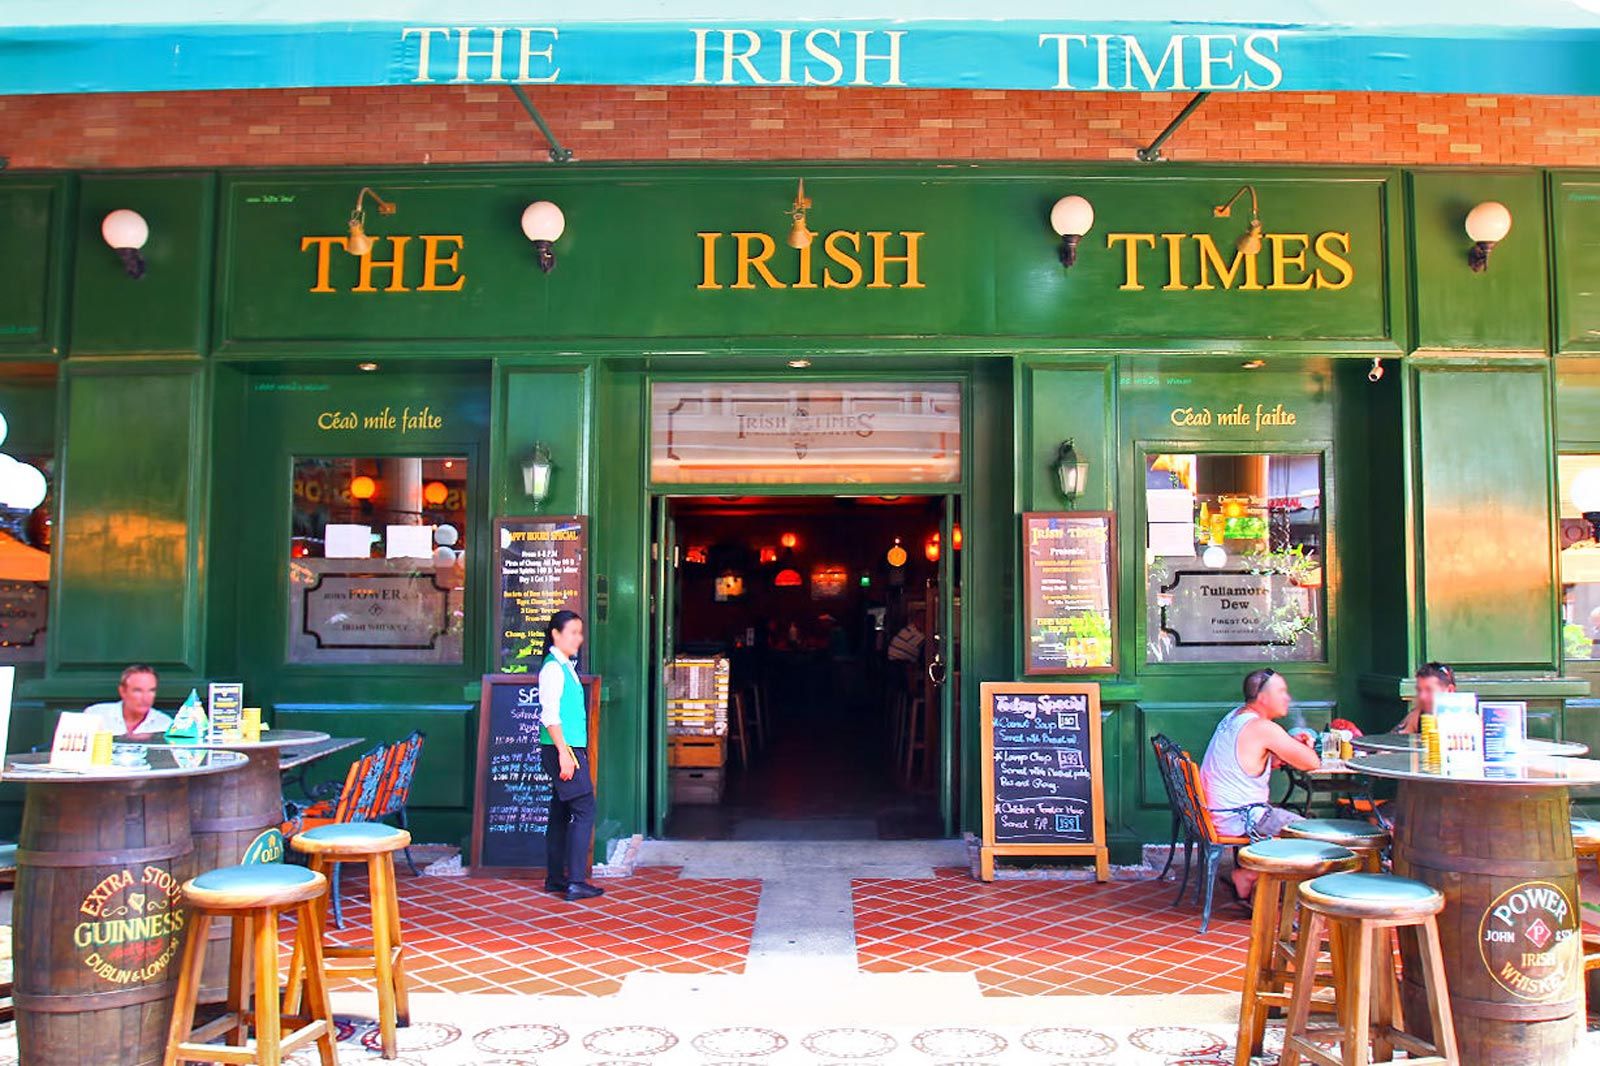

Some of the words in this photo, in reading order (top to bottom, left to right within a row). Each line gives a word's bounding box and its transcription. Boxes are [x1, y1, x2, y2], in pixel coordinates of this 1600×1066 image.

[401, 26, 560, 84] THE
[688, 28, 907, 87] IRISH
[1038, 33, 1283, 92] TIMES
[300, 233, 467, 294] THE
[696, 230, 926, 291] IRISH
[1107, 231, 1355, 293] TIMES
[317, 410, 359, 430] Céad
[363, 406, 397, 430] mile
[402, 406, 443, 435] failte
[1170, 406, 1212, 428] Céad
[1217, 403, 1250, 427] mile
[1255, 403, 1297, 433] failte
[1199, 585, 1270, 597] Tullamore
[1221, 598, 1250, 610] Dew
[518, 687, 540, 704] SP
[995, 695, 1037, 720] Today
[1037, 694, 1087, 716] Special
[1034, 717, 1058, 734] Soup
[79, 869, 134, 918] EXTRA
[141, 865, 183, 904] STOUT
[1492, 887, 1568, 927] POWER
[73, 908, 186, 948] GUINNESS
[1484, 929, 1516, 943] JOHN
[1534, 925, 1545, 941] P
[83, 951, 131, 985] DUBLIN
[140, 937, 181, 981] LONDON
[1521, 952, 1556, 968] IRISH
